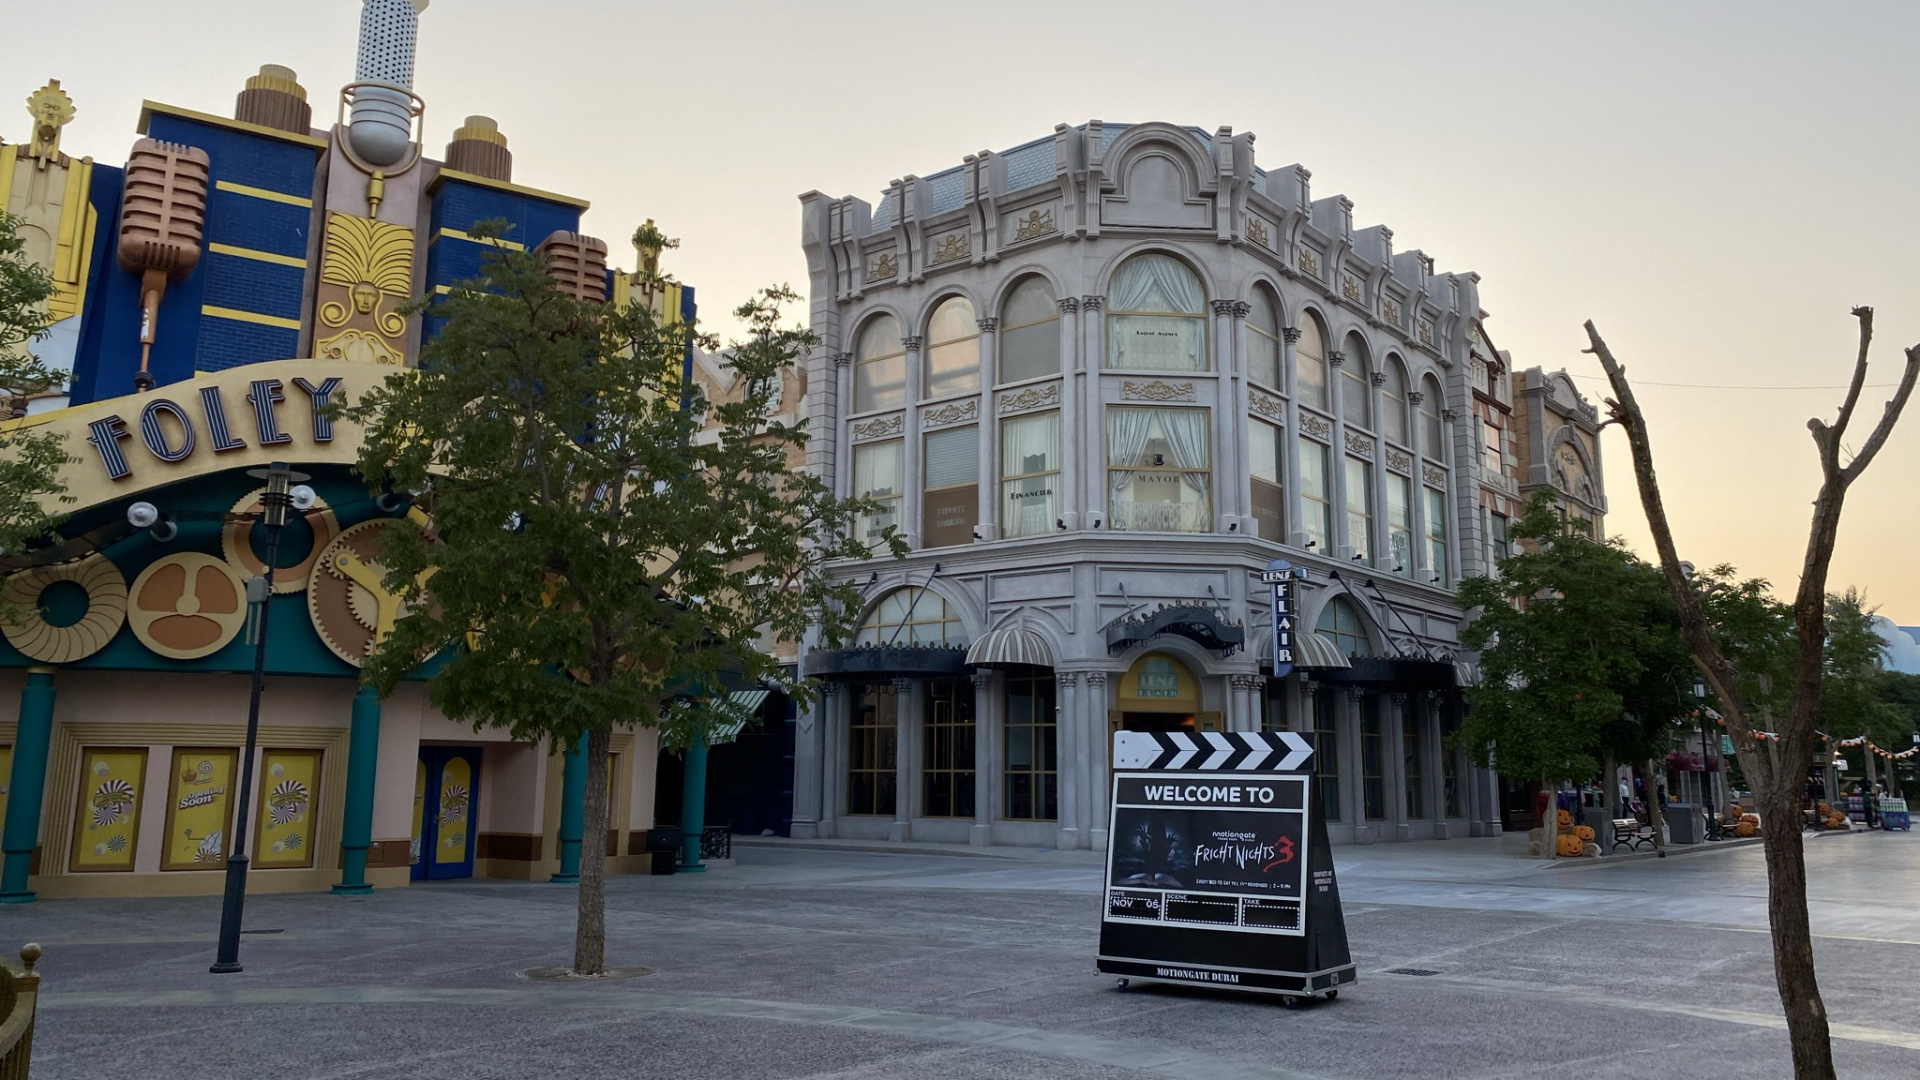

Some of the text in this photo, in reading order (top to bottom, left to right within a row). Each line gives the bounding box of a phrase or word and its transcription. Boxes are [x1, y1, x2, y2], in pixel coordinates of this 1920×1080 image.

[87, 377, 343, 481] FOLEY
[1138, 475, 1180, 484] MAYOR
[1011, 488, 1053, 500] FINANCIER
[1263, 571, 1291, 581] LENS
[1277, 584, 1292, 662] FLAIR
[1140, 675, 1177, 686] LENS
[1139, 689, 1178, 697] FLAIR
[188, 787, 224, 799] Opening
[1144, 785, 1274, 804] WELCOME TO
[180, 795, 212, 809] Soon
[1212, 830, 1256, 842] motiongate
[1195, 835, 1294, 873] FRIGHT NIGHTS 3
[1112, 899, 1159, 909] NOV 05
[1156, 967, 1239, 983] MOTIONGATE DUBAI
